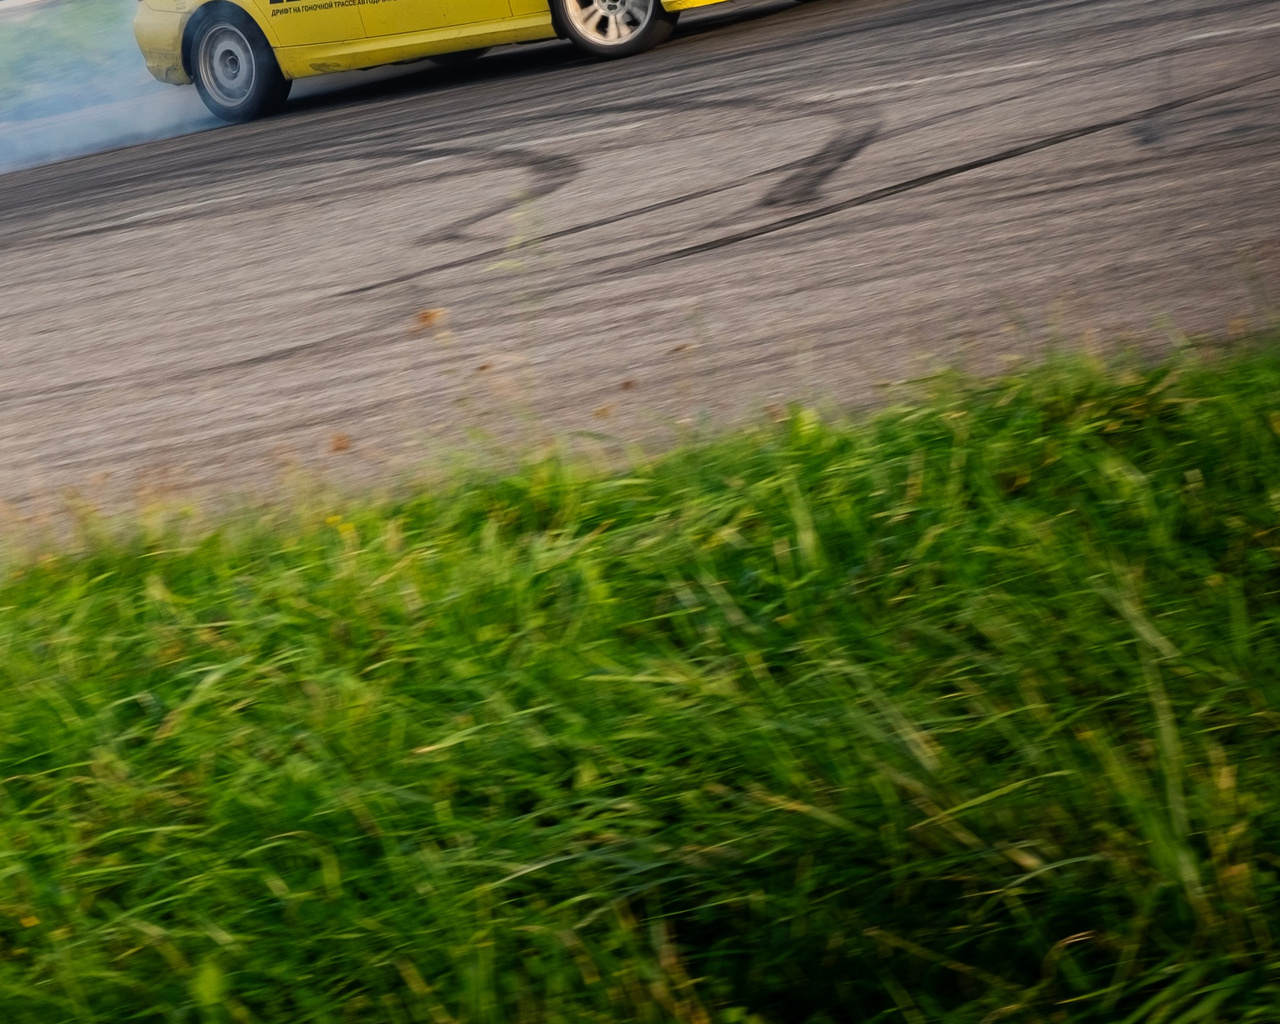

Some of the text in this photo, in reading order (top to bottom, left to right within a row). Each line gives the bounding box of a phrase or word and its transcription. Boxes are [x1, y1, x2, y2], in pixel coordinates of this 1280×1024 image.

[271, 7, 293, 17] ДРИФТ
[293, 6, 301, 14] НА
[301, 1, 333, 13] ГОНОЧНОЙ
